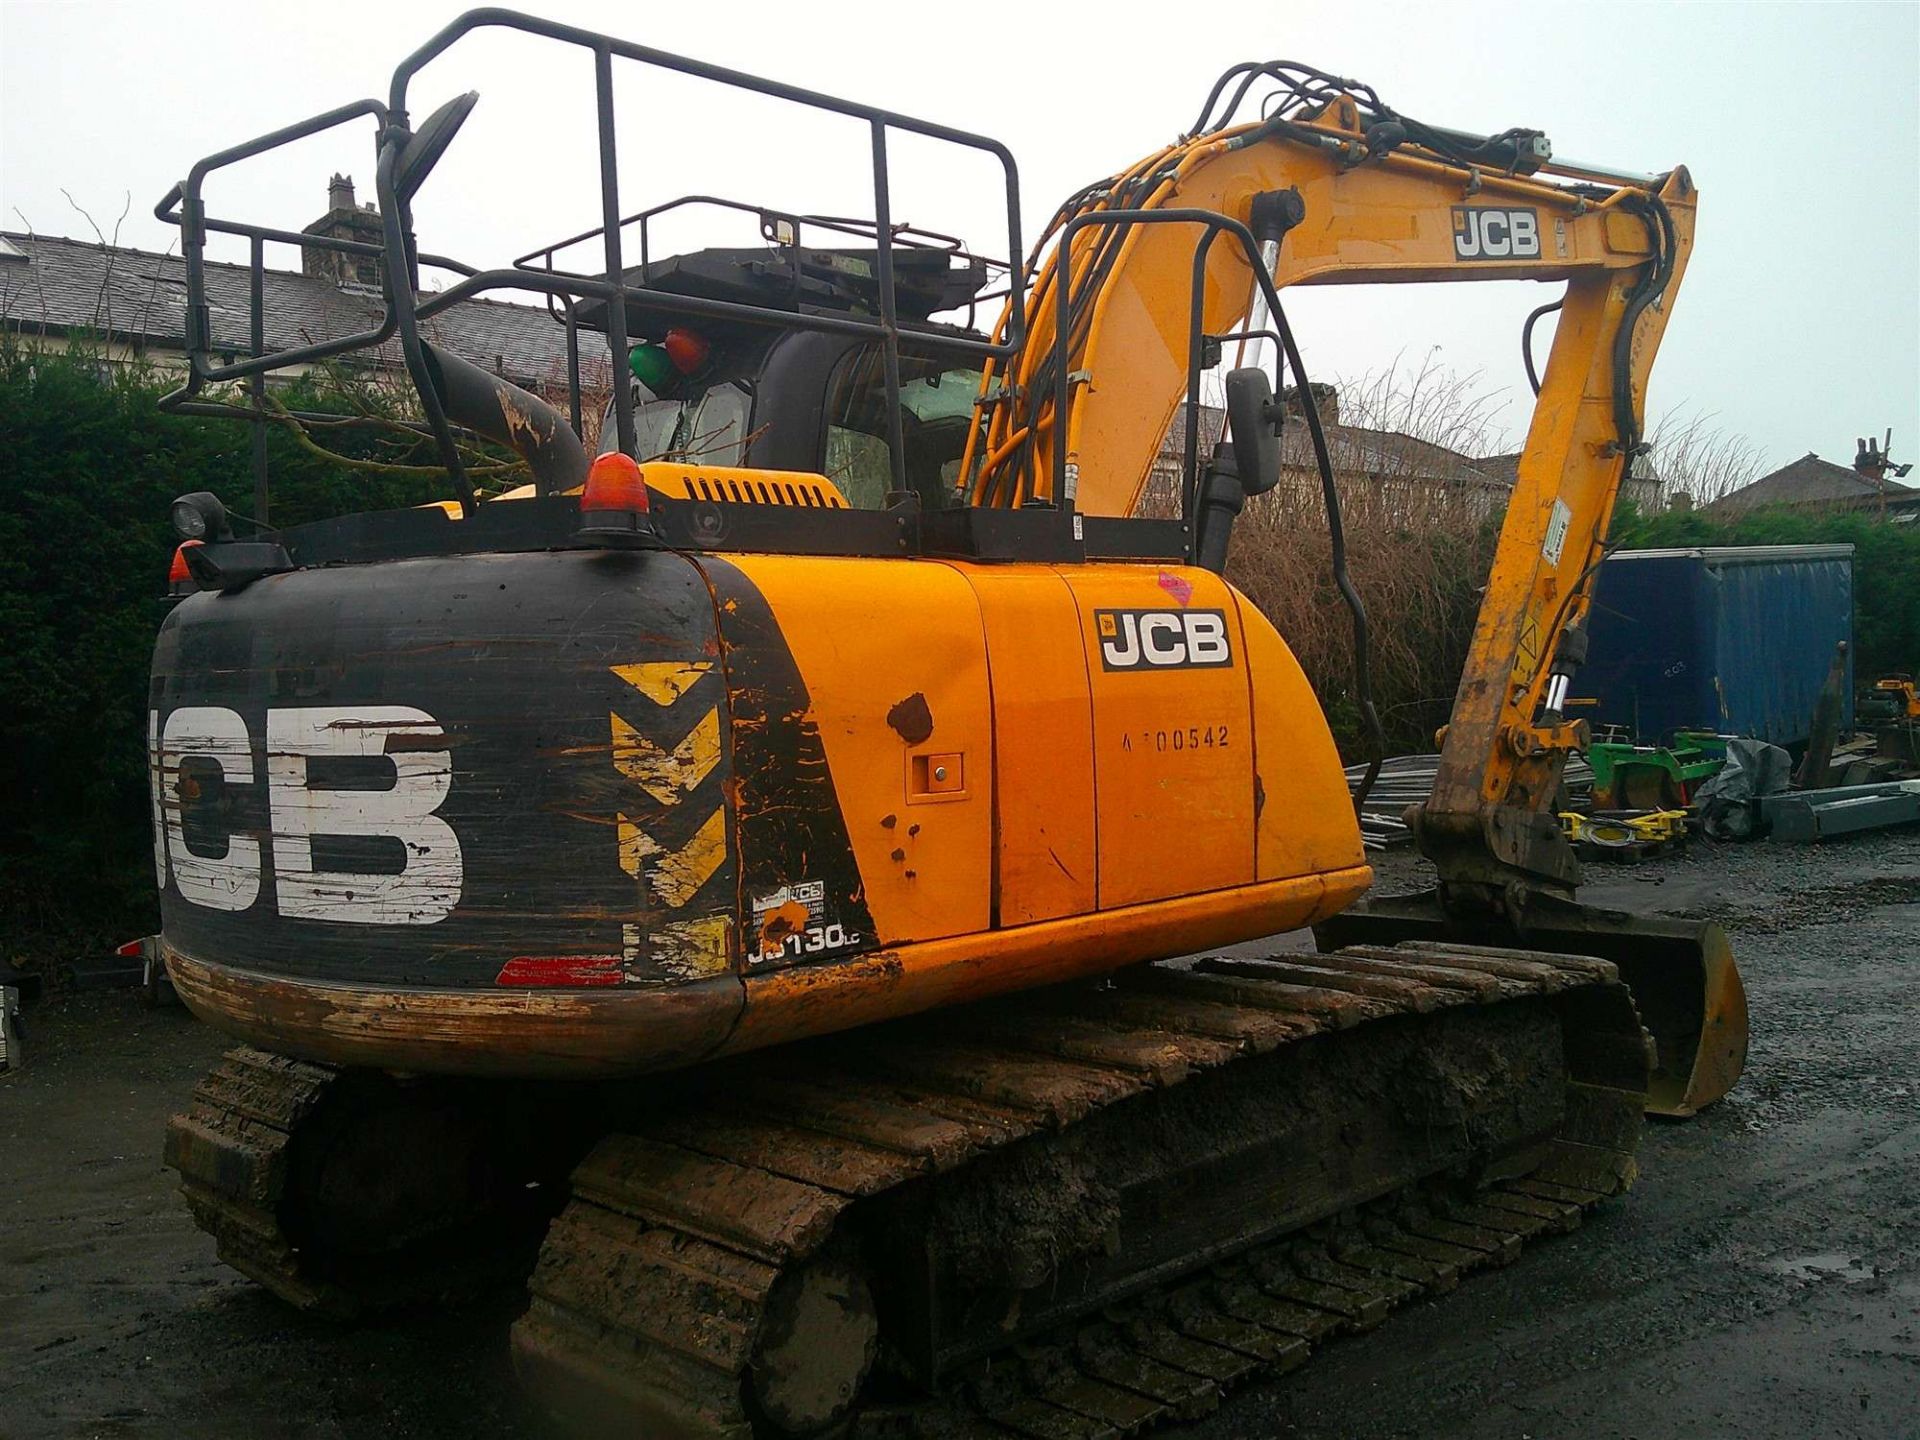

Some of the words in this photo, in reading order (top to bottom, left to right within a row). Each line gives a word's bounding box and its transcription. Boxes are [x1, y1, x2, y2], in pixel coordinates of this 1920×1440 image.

[1455, 210, 1539, 256] JCB
[1103, 613, 1229, 666] JCB
[1122, 725, 1229, 753] A00542
